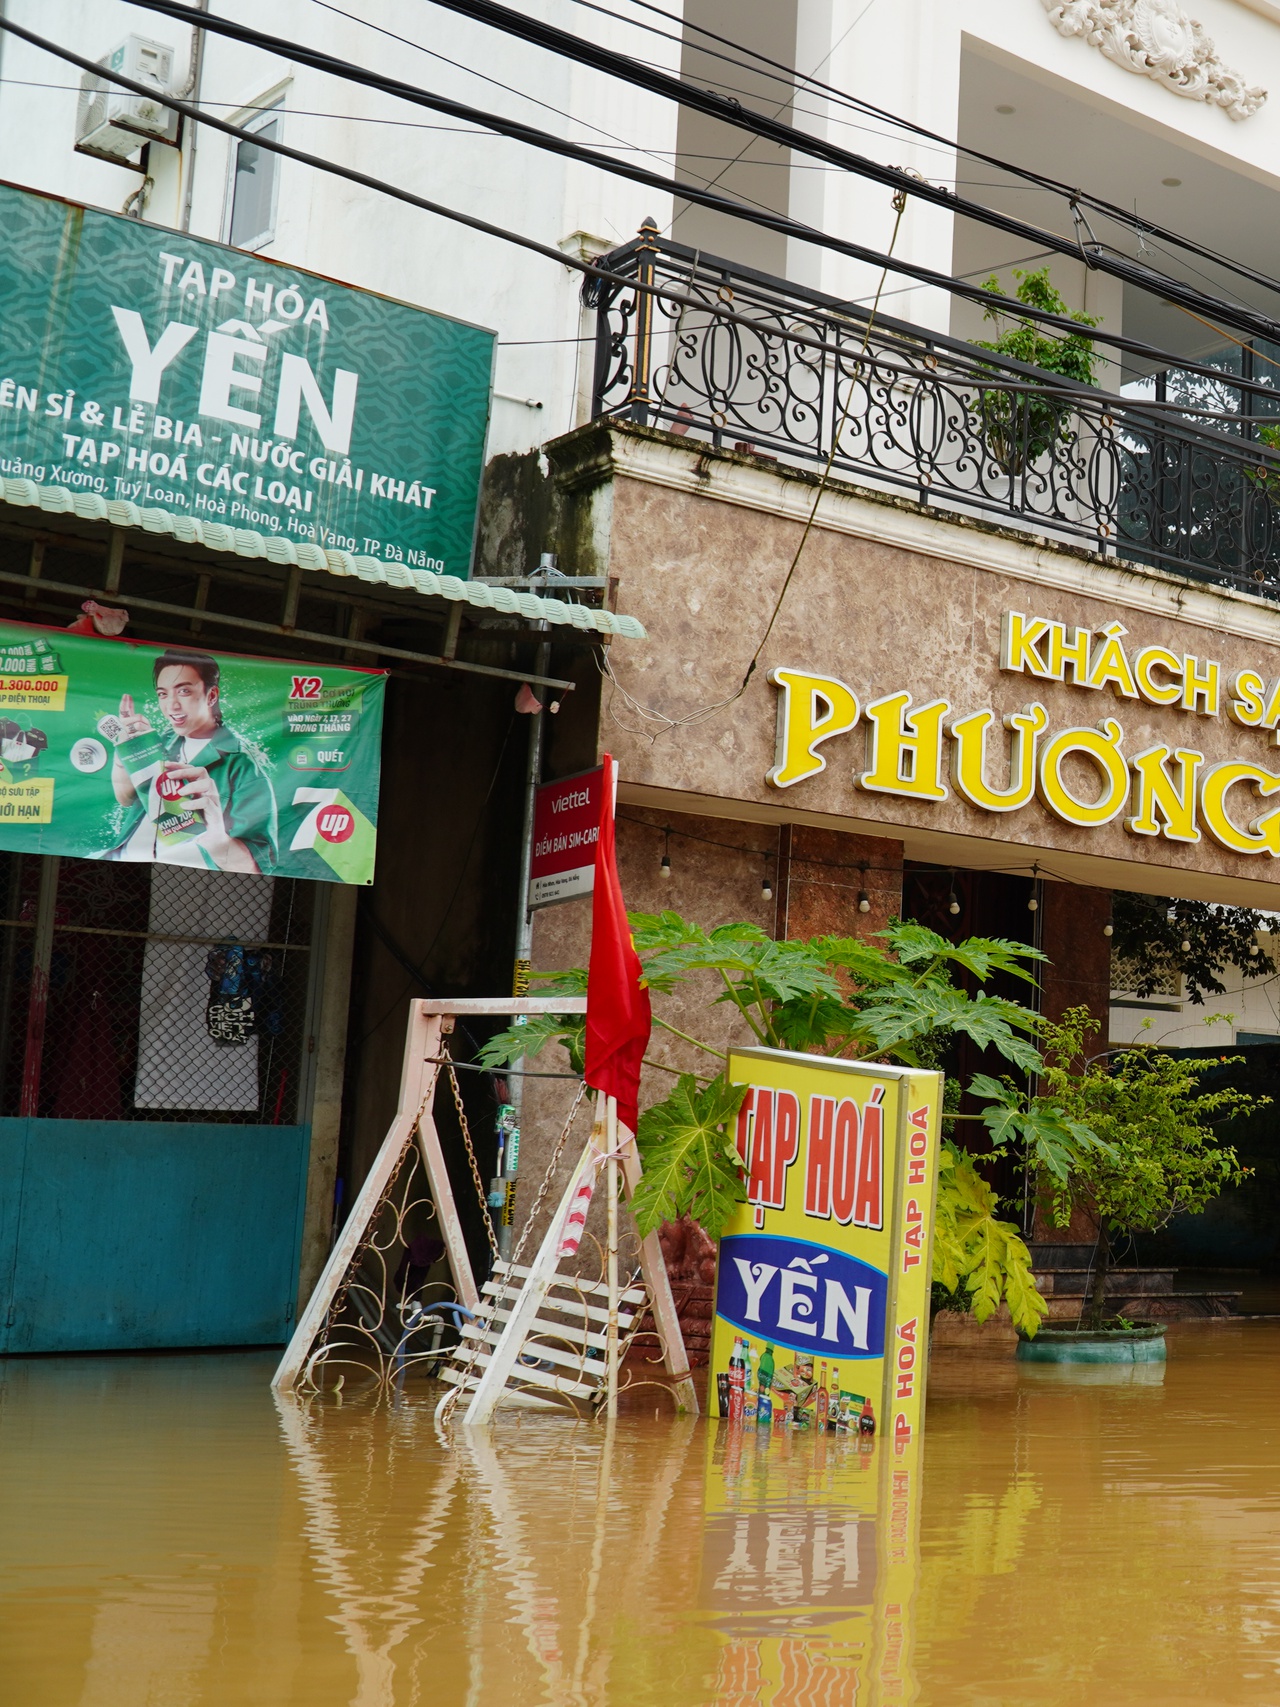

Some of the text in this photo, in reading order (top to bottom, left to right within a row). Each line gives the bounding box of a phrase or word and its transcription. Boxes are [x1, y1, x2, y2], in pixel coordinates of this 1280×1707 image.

[158, 251, 330, 331] TẠP HÓA
[110, 305, 358, 455] YẾN
[0, 378, 38, 413] ÊN
[45, 389, 76, 420] SỈ
[80, 401, 105, 426] &
[112, 404, 146, 434] LẺ
[153, 415, 203, 447] BIA
[229, 432, 305, 473] NƯỚC
[309, 458, 364, 490] GIẢI
[370, 473, 436, 510] KHÁT
[62, 433, 313, 514] TẠP HOÁ CÁC LOẠI
[1, 457, 45, 482] uảng
[51, 464, 109, 493] Xương,
[146, 483, 190, 508] Loan,
[195, 492, 226, 515] Hoà
[231, 501, 283, 531] Phong,
[287, 517, 315, 539] Hoà
[319, 524, 360, 553] Vang,
[363, 537, 380, 557] TP.
[384, 545, 404, 562] Đà
[407, 549, 444, 575] Nẵng
[290, 676, 323, 699] X2
[999, 610, 1221, 717] KHÁCH
[290, 722, 351, 732] TRONG THÁNG
[317, 748, 344, 763] QUÉT
[0, 802, 40, 820] IỚI HẠN
[551, 788, 590, 814] viettel
[535, 832, 552, 857] ĐIỂM
[553, 832, 567, 851] BÁN
[735, 1082, 885, 1230] TẠP HOÁ
[903, 1104, 930, 1273] TẠP HOÁ
[732, 1253, 873, 1351] YẾN
[895, 1317, 918, 1401] HOÁ
